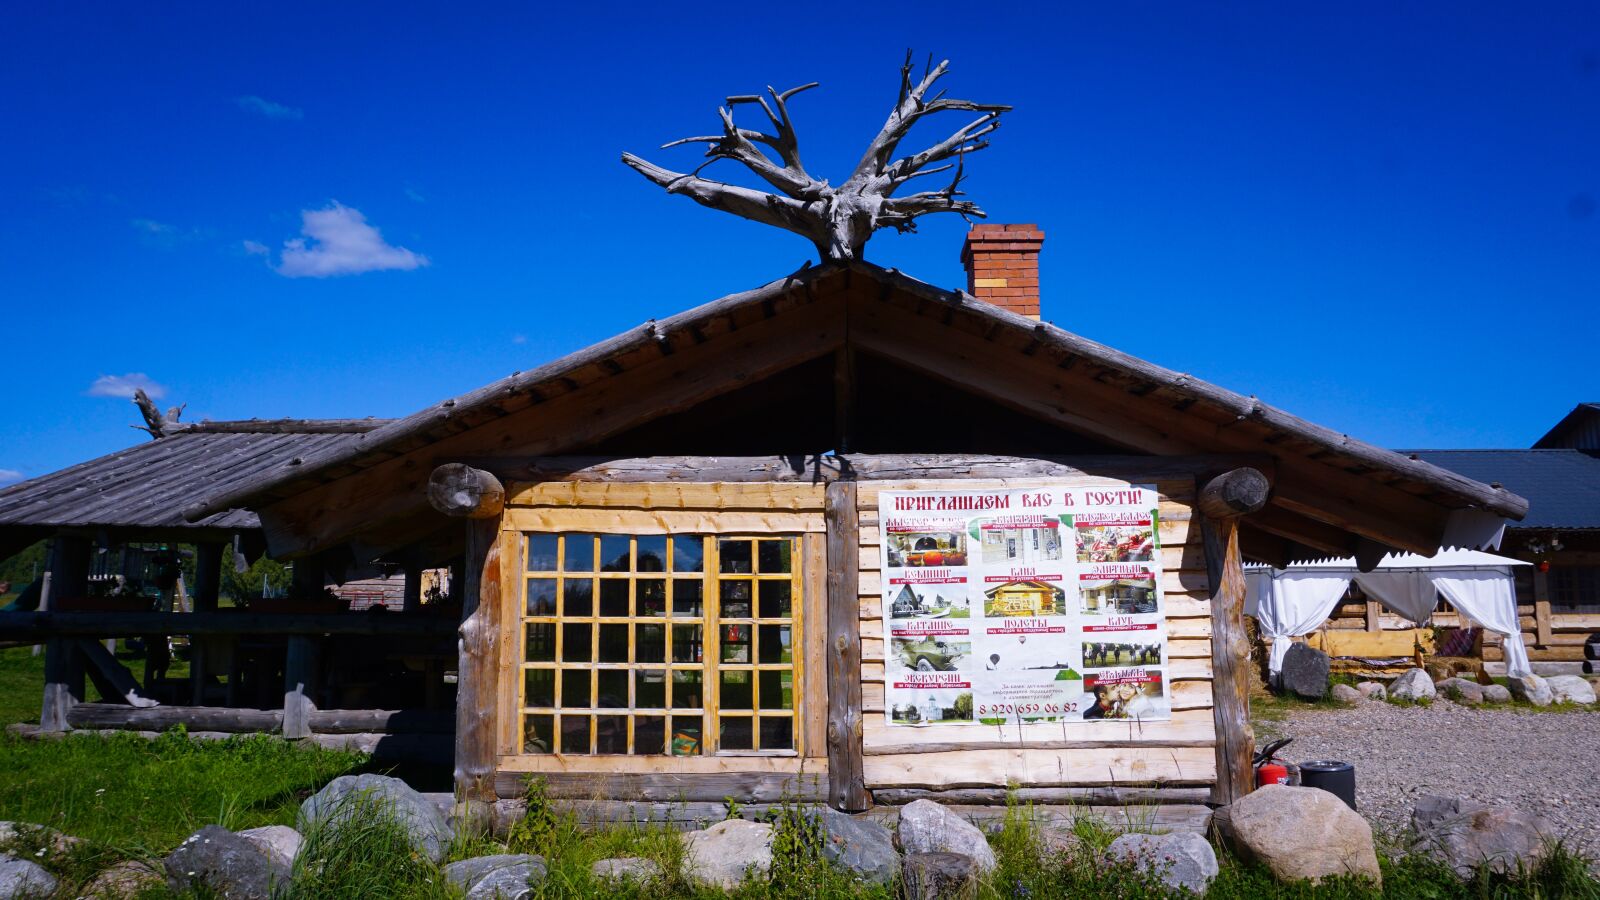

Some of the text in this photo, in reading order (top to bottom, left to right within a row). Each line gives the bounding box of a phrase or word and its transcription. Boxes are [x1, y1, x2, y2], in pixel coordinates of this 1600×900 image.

[895, 489, 1143, 511] ПРИГЛАШАЕМ ВАС В ГОСТИ!
[1075, 511, 1151, 521] МАСТЕР-КЛАСС
[904, 569, 952, 578] КЕМПИНГ
[1011, 567, 1036, 576] БАНЯ
[907, 620, 953, 630] КАТАНИЕ
[1108, 616, 1134, 626] КЛУБ
[904, 674, 960, 683] ЭКСКУРСИИ
[979, 702, 1078, 715] 8 920 659 06 82
